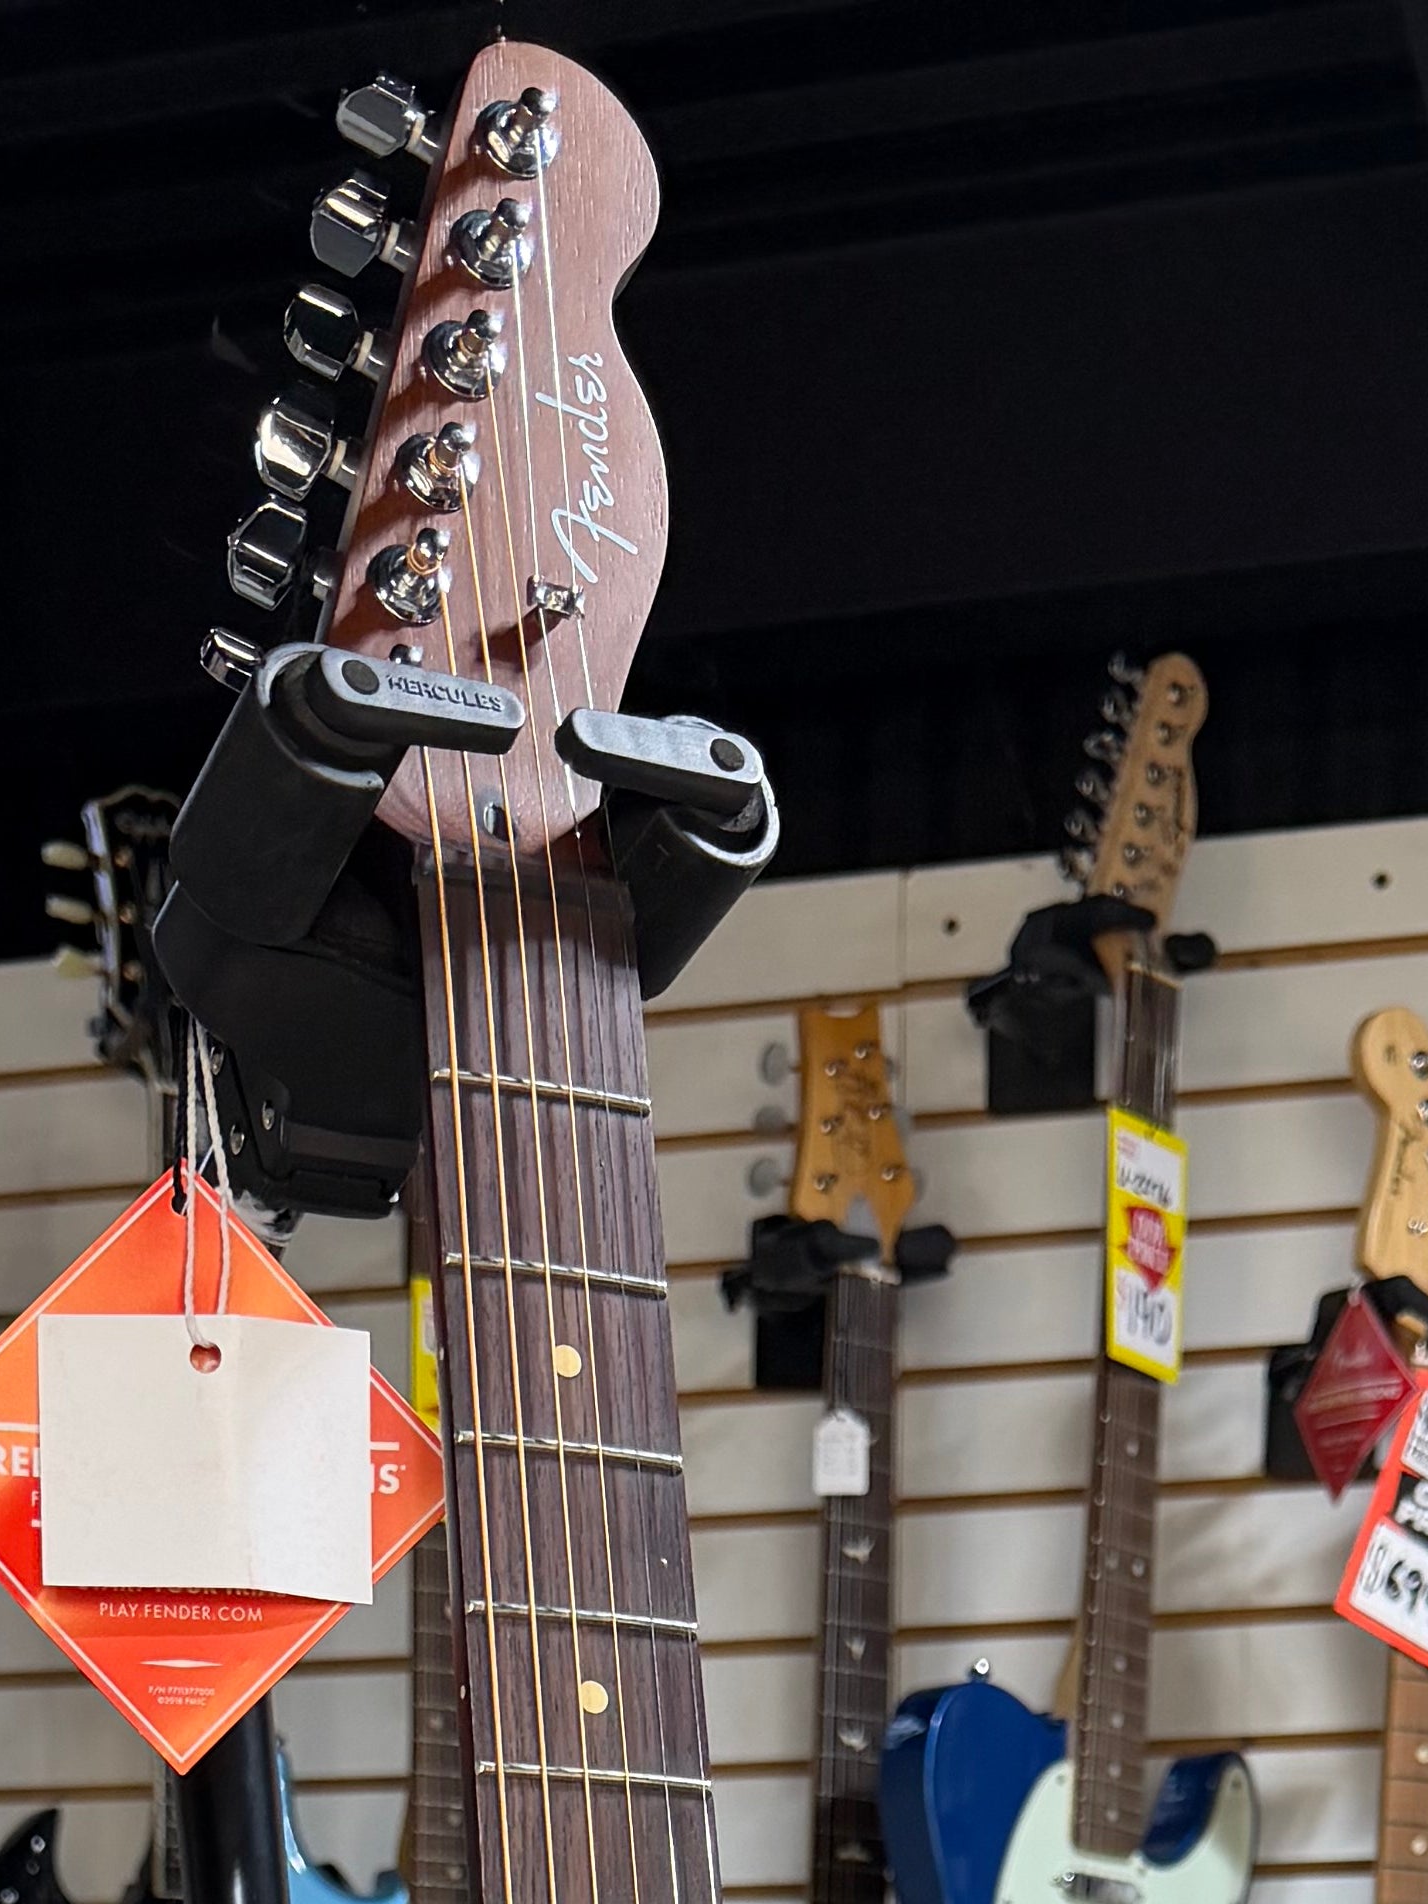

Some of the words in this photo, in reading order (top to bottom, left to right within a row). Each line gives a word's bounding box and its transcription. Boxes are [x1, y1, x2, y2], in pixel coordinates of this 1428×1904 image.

[536, 350, 639, 585] Fender
[385, 674, 503, 713] HERCULES
[98, 1602, 264, 1623] PLAY.FENDER.COM
